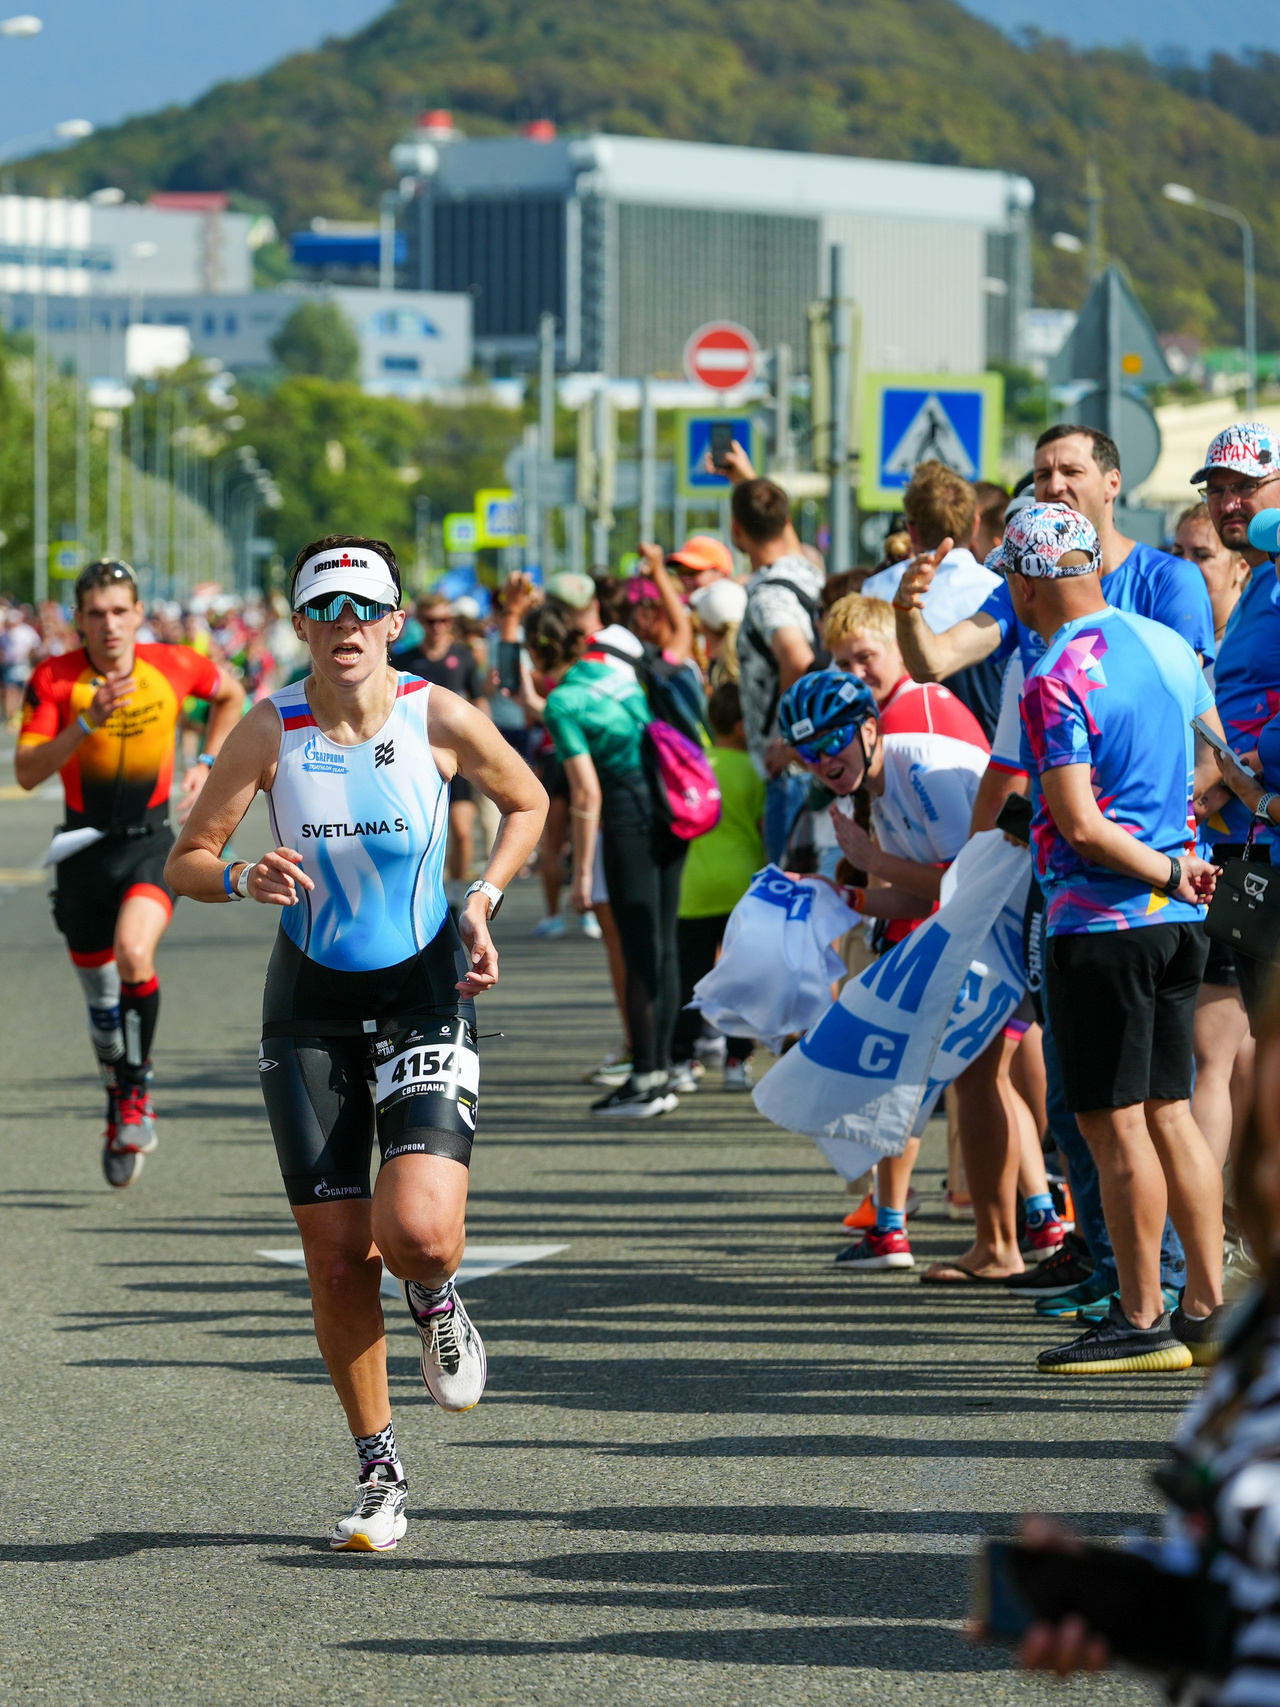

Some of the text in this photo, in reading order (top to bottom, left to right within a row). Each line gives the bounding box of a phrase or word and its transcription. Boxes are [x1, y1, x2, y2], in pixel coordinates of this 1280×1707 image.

[314, 553, 369, 574] IRONMAN
[301, 818, 409, 838] SVETLANA S.
[391, 1051, 462, 1084] 4154
[402, 1083, 446, 1096] СВЕТЛАНА
[392, 1143, 426, 1156] GAZPROM
[330, 1186, 362, 1196] GAZPROM
